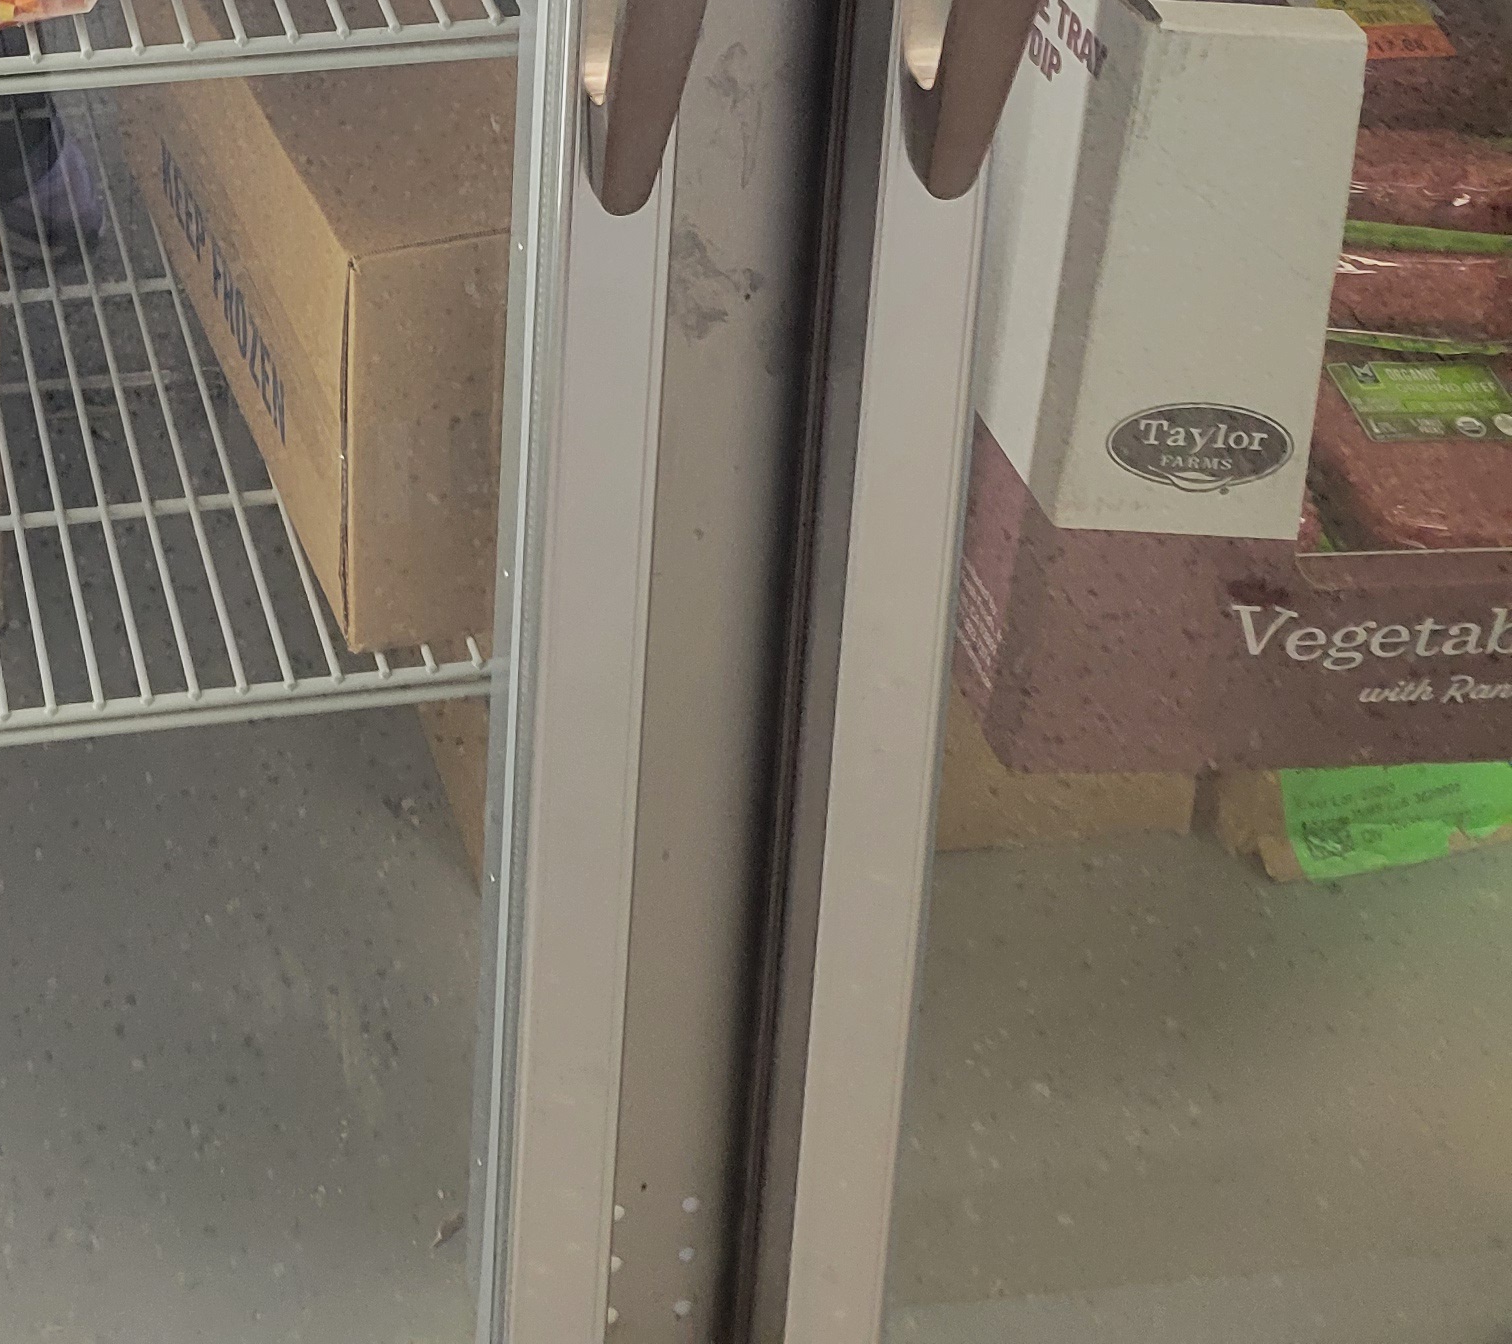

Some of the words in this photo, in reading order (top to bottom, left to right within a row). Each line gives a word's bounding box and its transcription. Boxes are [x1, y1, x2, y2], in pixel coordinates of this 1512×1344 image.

[212, 243, 287, 446] FROZEN
[1384, 367, 1442, 383] ORGANIC
[1138, 418, 1269, 456] Taylor
[1159, 454, 1233, 471] FARMS
[1231, 604, 1512, 672] Vegetab
[1358, 677, 1435, 703] with
